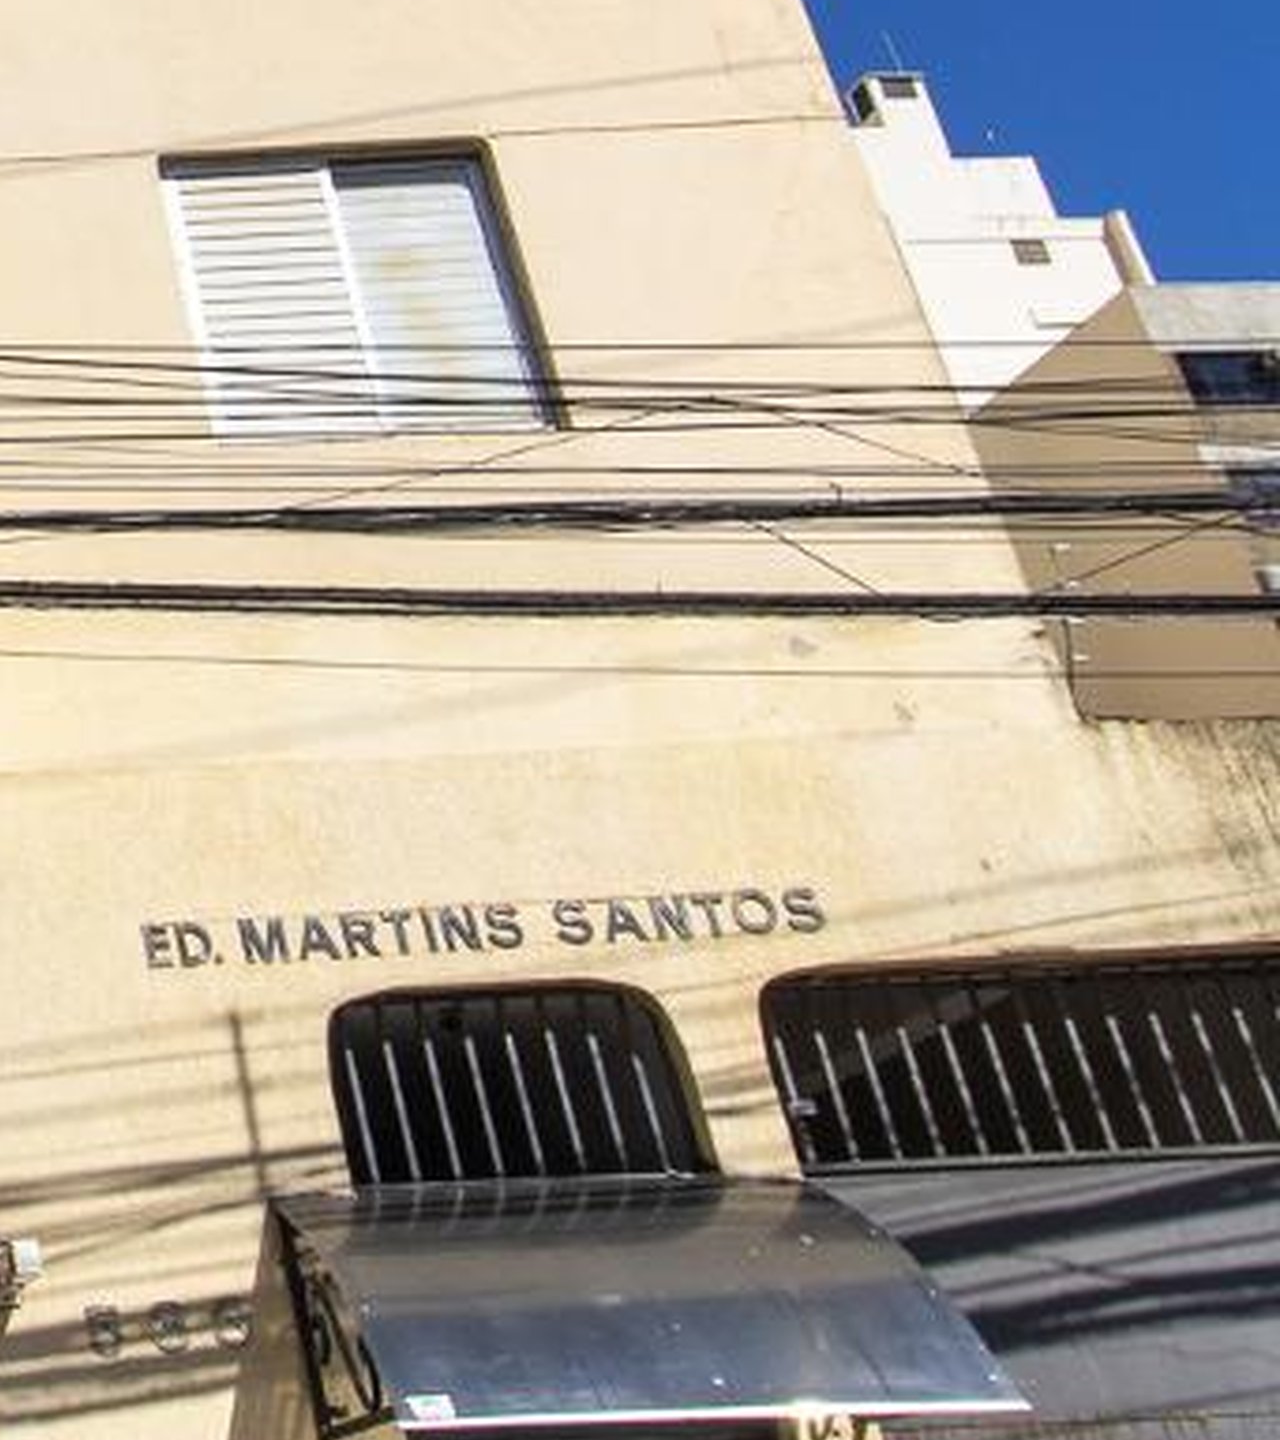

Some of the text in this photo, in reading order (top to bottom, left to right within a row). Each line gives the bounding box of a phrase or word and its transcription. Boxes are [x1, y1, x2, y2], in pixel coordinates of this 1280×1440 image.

[140, 887, 827, 970] ED. MARTINS SANTOS
